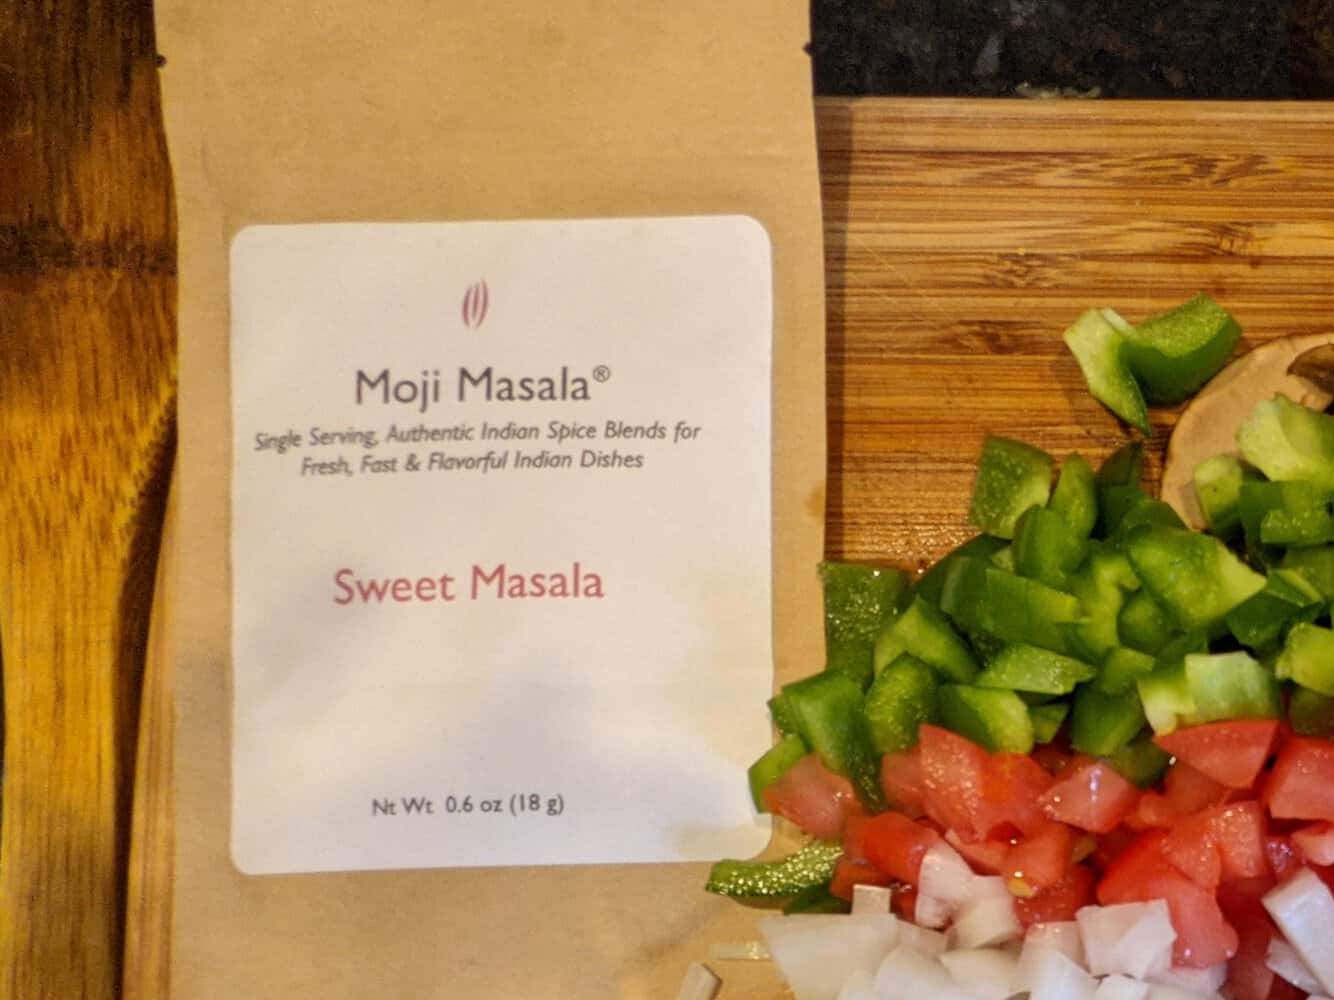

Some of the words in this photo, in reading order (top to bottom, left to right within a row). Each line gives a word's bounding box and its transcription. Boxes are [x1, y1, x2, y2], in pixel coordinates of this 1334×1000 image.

[355, 368, 440, 413] Moji
[254, 429, 301, 454] Single
[309, 427, 379, 450] Serving,
[386, 423, 475, 443] Authentic
[480, 421, 540, 441] Indian
[547, 420, 597, 444] Spice
[604, 420, 667, 440] Blends
[673, 420, 702, 444] for
[300, 455, 353, 477] Fresh,
[360, 454, 398, 474] Fast
[404, 453, 421, 472] &
[428, 450, 509, 474] Flavorful
[513, 450, 573, 469] Indian
[580, 449, 645, 469] Dishes
[333, 567, 456, 606] Sweet
[470, 561, 605, 600] Masala
[445, 795, 474, 814] 0.6
[480, 799, 503, 813] oz
[509, 793, 541, 816] (18
[546, 794, 565, 816] g)
